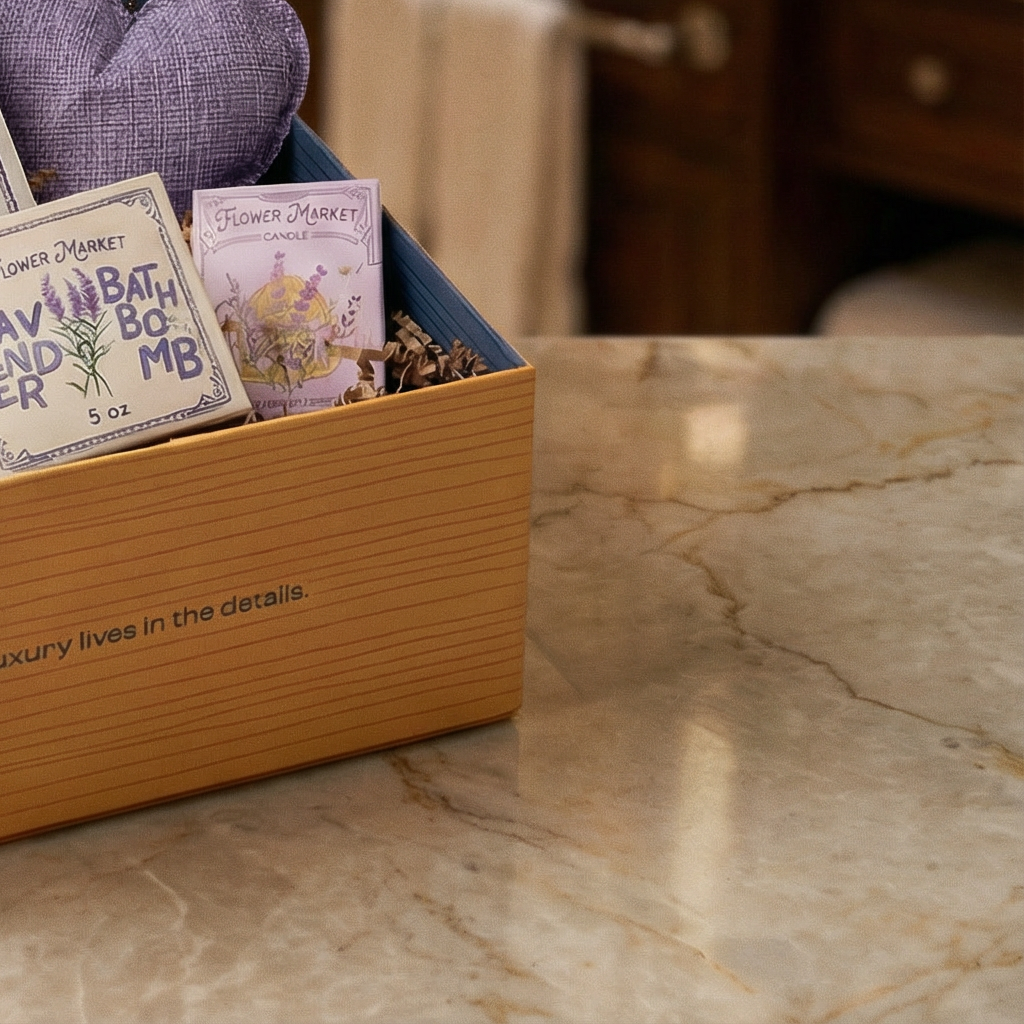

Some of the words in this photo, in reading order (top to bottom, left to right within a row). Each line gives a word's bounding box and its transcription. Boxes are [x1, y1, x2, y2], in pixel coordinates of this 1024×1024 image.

[96, 263, 178, 309] BATH
[115, 303, 168, 340] BO
[139, 337, 203, 380] MB
[88, 408, 101, 425] 5
[80, 624, 137, 651] lives
[143, 616, 165, 636] in
[173, 606, 214, 628] the
[220, 584, 309, 617] details.
